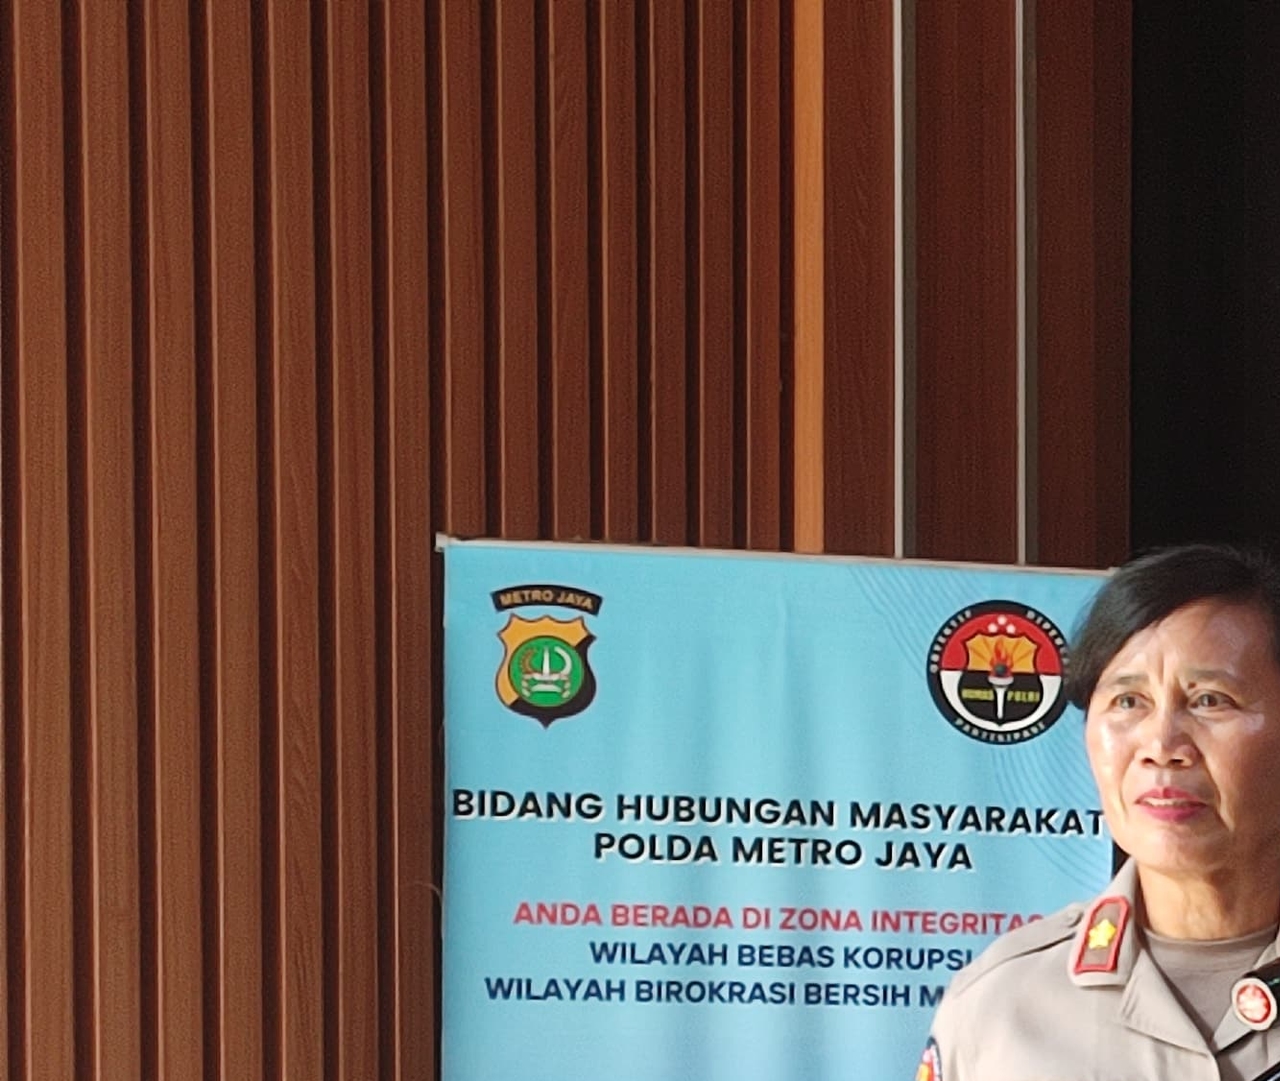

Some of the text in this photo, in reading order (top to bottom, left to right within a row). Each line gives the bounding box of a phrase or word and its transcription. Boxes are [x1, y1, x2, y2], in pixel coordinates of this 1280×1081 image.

[500, 589, 594, 609] METRO JAYA
[453, 788, 1105, 836] BIDANG HUBUNGAN MASYARAKAT
[594, 832, 973, 870] POLDA METRO JAYA
[513, 902, 602, 926] ANDA
[611, 904, 734, 929] BERADA
[743, 907, 771, 930] DI
[779, 908, 865, 932] ZONA
[589, 941, 973, 971] WILAYAH BEBAS KORUPSI
[484, 977, 626, 1002] WILAYAH
[635, 980, 796, 1005] BIROKRASI
[804, 983, 911, 1007] BERSIH
